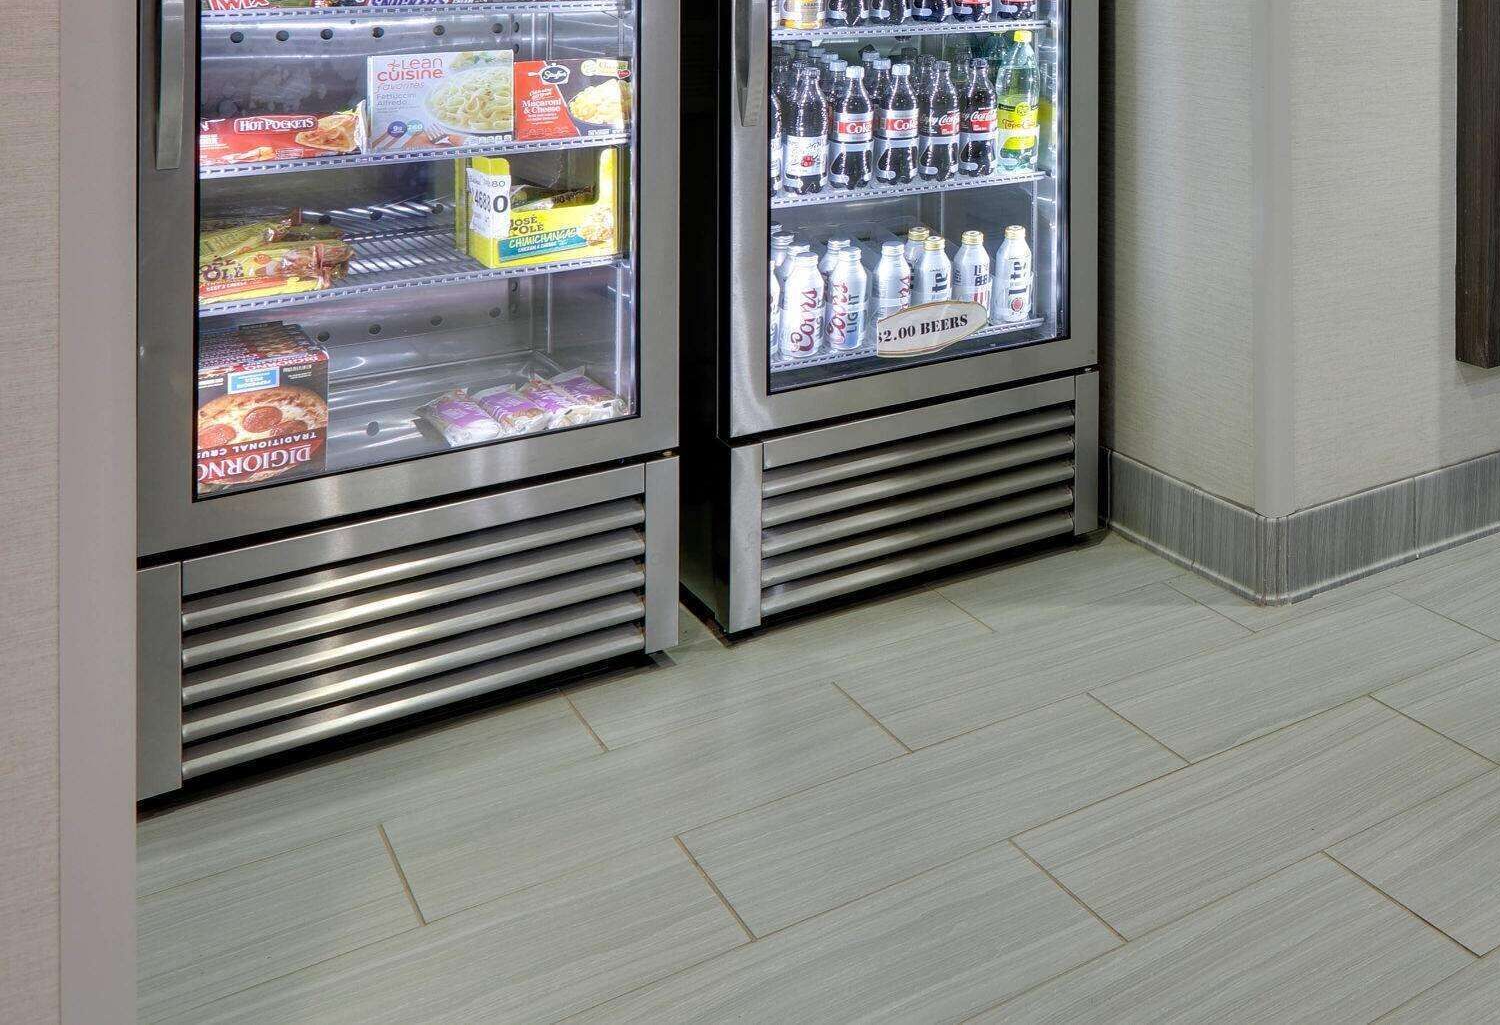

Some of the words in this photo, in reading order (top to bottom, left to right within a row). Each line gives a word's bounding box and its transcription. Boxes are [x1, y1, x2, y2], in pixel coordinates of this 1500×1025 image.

[522, 98, 561, 108] Macaroni
[920, 314, 968, 335] BEERS
[232, 431, 317, 453] TRADITIONAL
